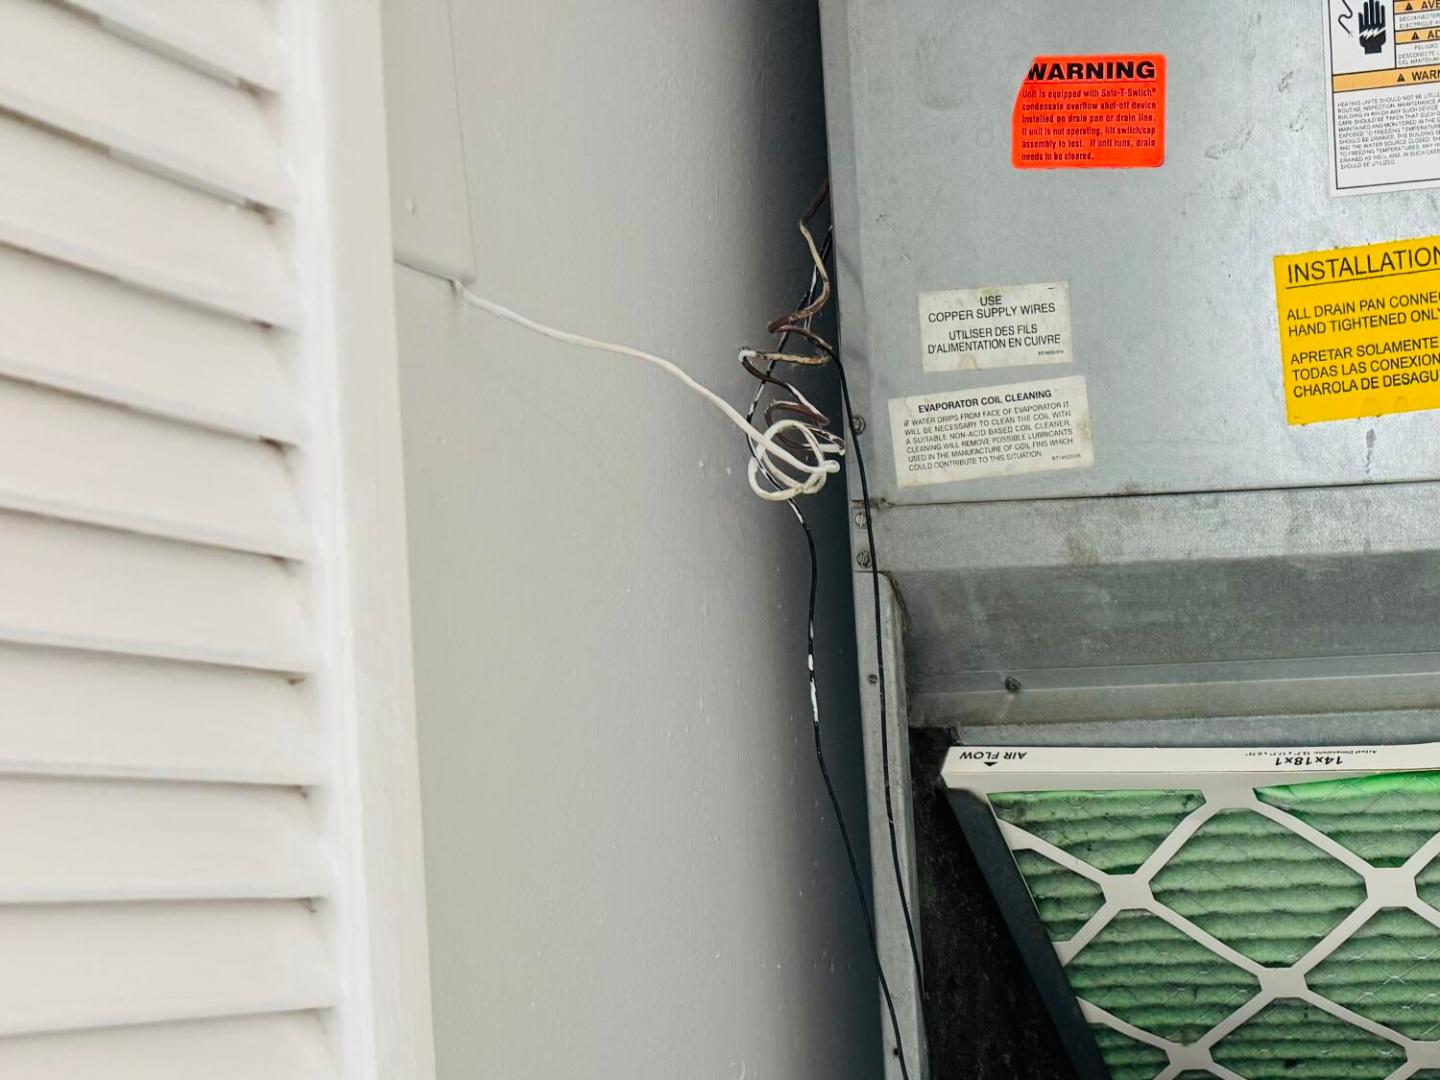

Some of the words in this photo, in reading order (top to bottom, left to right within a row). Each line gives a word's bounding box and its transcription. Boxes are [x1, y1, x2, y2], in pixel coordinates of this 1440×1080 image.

[1028, 61, 1155, 80] WARNING
[980, 295, 1002, 306] USE
[1287, 307, 1311, 321] ALL
[1314, 302, 1355, 318] DRAIN
[1359, 297, 1385, 311] PAN
[928, 309, 974, 323] COPPER
[976, 306, 1017, 319] SUPPLY
[1020, 302, 1056, 315] WIRES
[949, 327, 992, 340] UTILISER
[994, 325, 1015, 336] DES
[1017, 323, 1038, 334] FILS
[1288, 322, 1326, 337] HAND
[1329, 312, 1407, 332] TIGHTENED
[928, 338, 1006, 354] D'ALIMENTATION
[1008, 337, 1022, 348] EN
[1024, 334, 1060, 347] CUIVRE
[1291, 346, 1353, 365] APRETAR
[1356, 336, 1439, 357] SOLAMENTE
[1292, 365, 1338, 381] TODAS
[1341, 361, 1367, 376] LAS
[1293, 379, 1358, 398] CHAROLA
[1361, 376, 1379, 390] DE
[918, 398, 979, 413] EVAPORATOR
[981, 396, 1002, 406] COIL
[1004, 390, 1052, 403] CLEANING
[959, 751, 1000, 761] FLOW
[1003, 750, 1028, 760] AIR
[1274, 755, 1344, 766] 14x18x1
